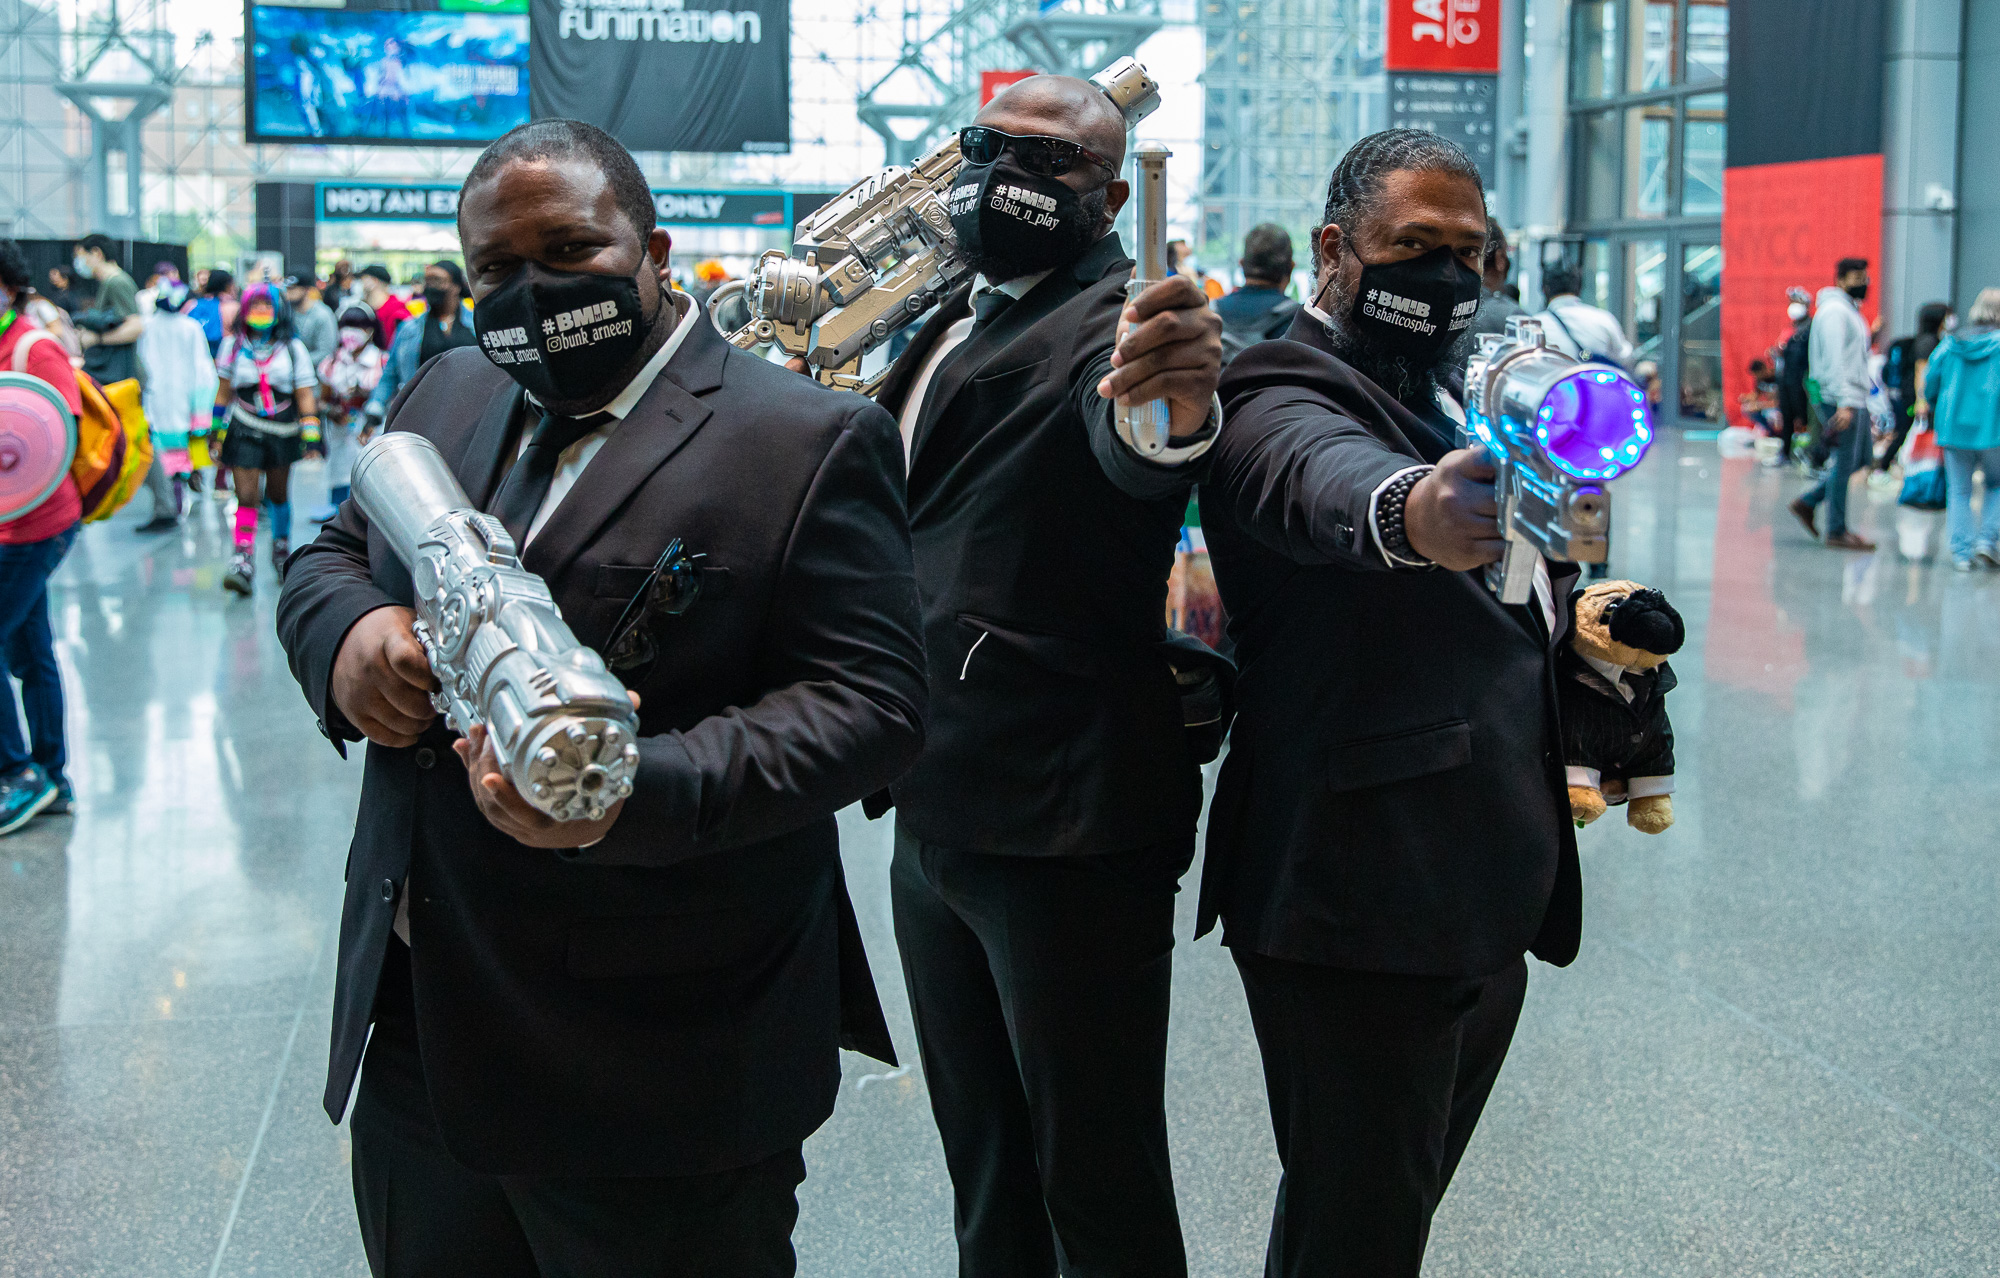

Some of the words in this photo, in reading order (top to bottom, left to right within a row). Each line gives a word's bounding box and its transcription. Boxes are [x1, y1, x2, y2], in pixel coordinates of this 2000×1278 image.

[325, 188, 387, 213] NOT
[383, 189, 426, 214] AN
[656, 193, 726, 218] ONLY
[561, 319, 632, 350] bunk_arneezy
[1375, 307, 1437, 336] shaftcosplay
